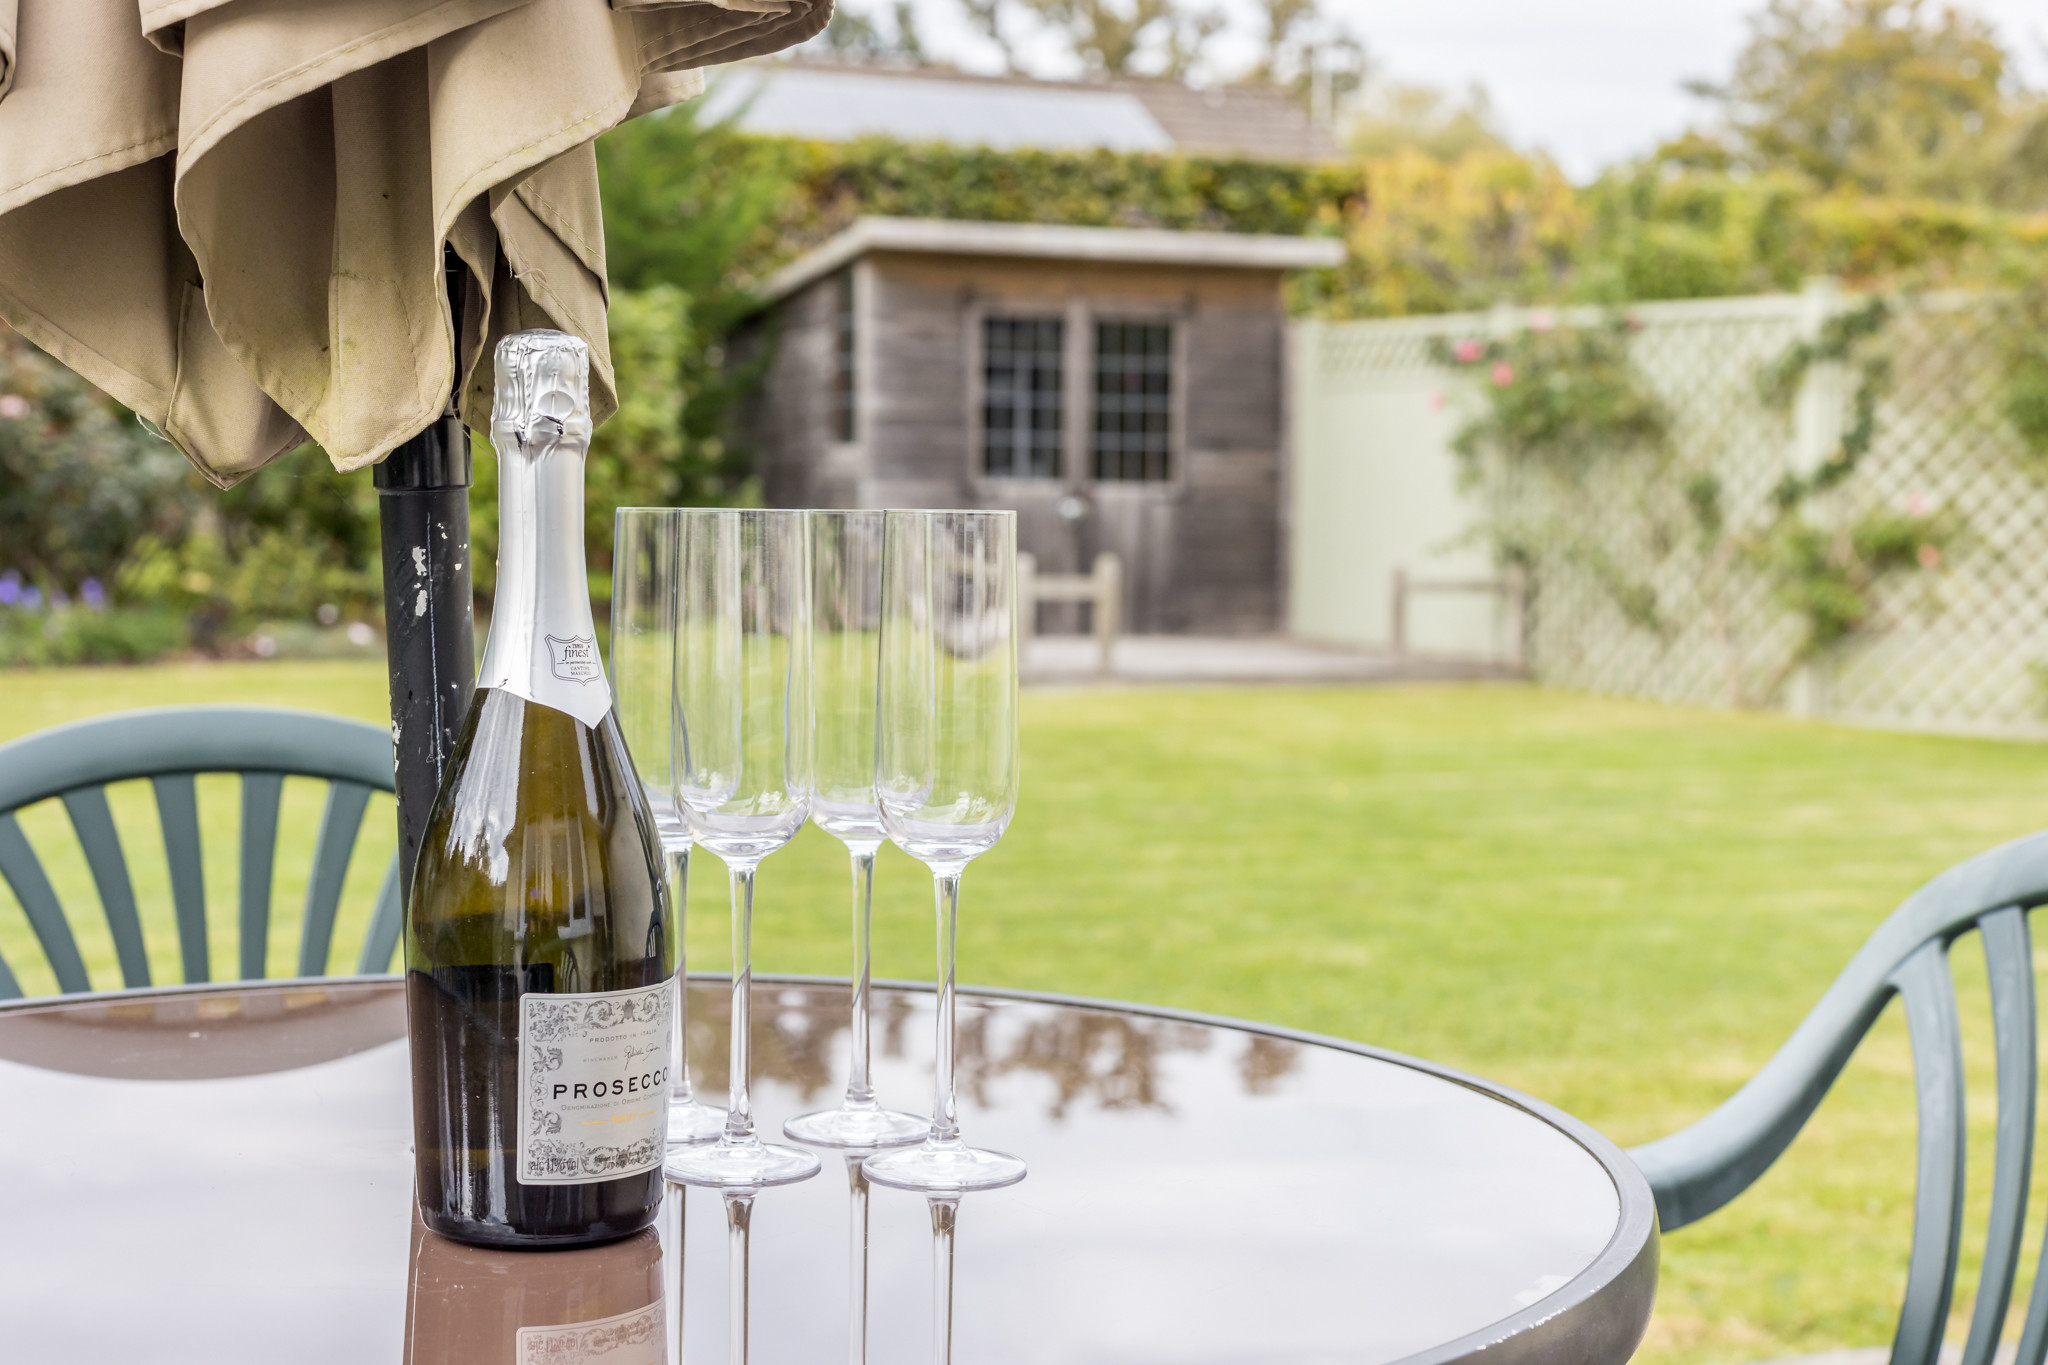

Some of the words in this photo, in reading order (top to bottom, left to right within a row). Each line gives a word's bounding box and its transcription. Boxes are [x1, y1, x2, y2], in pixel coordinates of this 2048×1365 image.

[562, 645, 589, 661] finest
[589, 1035, 628, 1043] PRODOTTO
[640, 1028, 657, 1037] ITALIA
[552, 1066, 668, 1100] PROSECCO
[611, 1112, 637, 1125] BRUT
